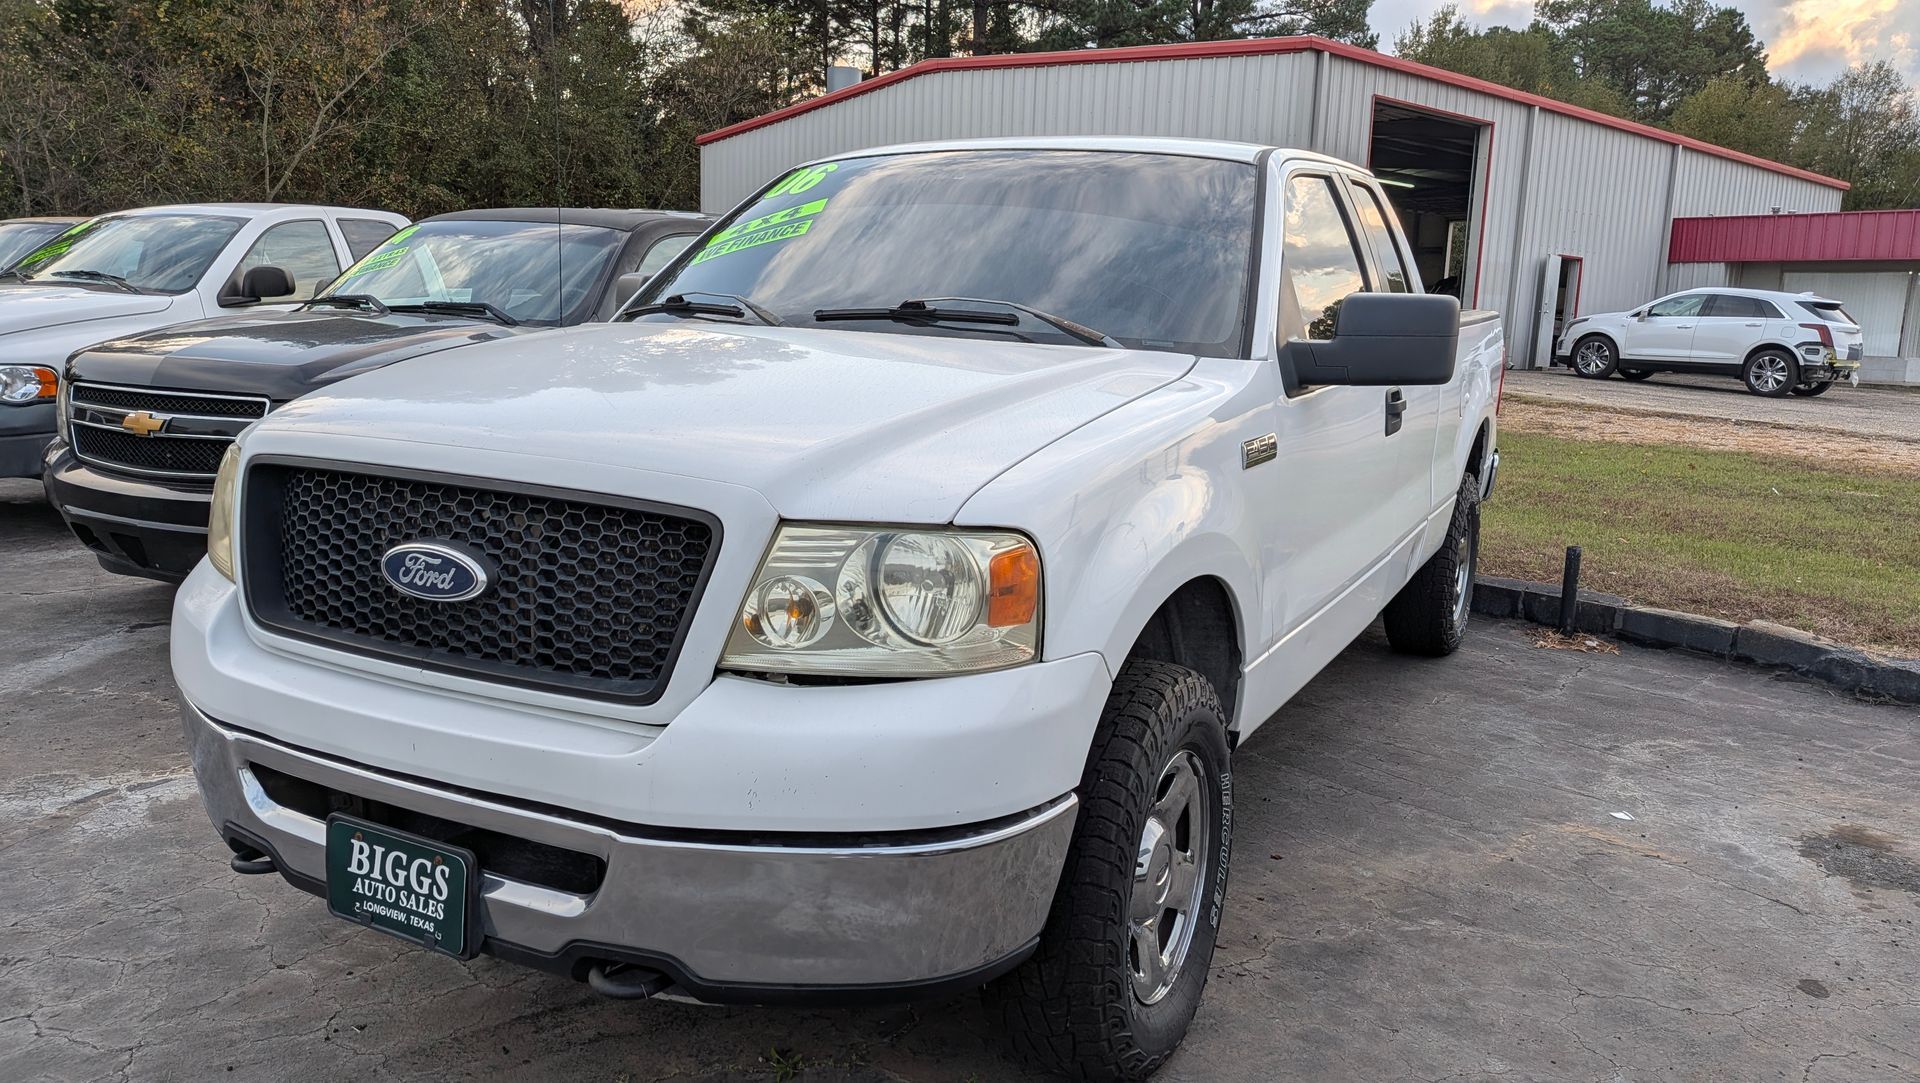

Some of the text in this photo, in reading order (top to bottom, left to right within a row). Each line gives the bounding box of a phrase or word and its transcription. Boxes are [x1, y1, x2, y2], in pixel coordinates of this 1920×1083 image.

[724, 221, 807, 252] FINANCE
[399, 553, 456, 590] Ford
[347, 838, 450, 901] BIGGS
[1210, 772, 1231, 929] HERCULES
[352, 877, 445, 920] AUTO SALES
[363, 900, 434, 932] LONGVIEW, TEXAS
